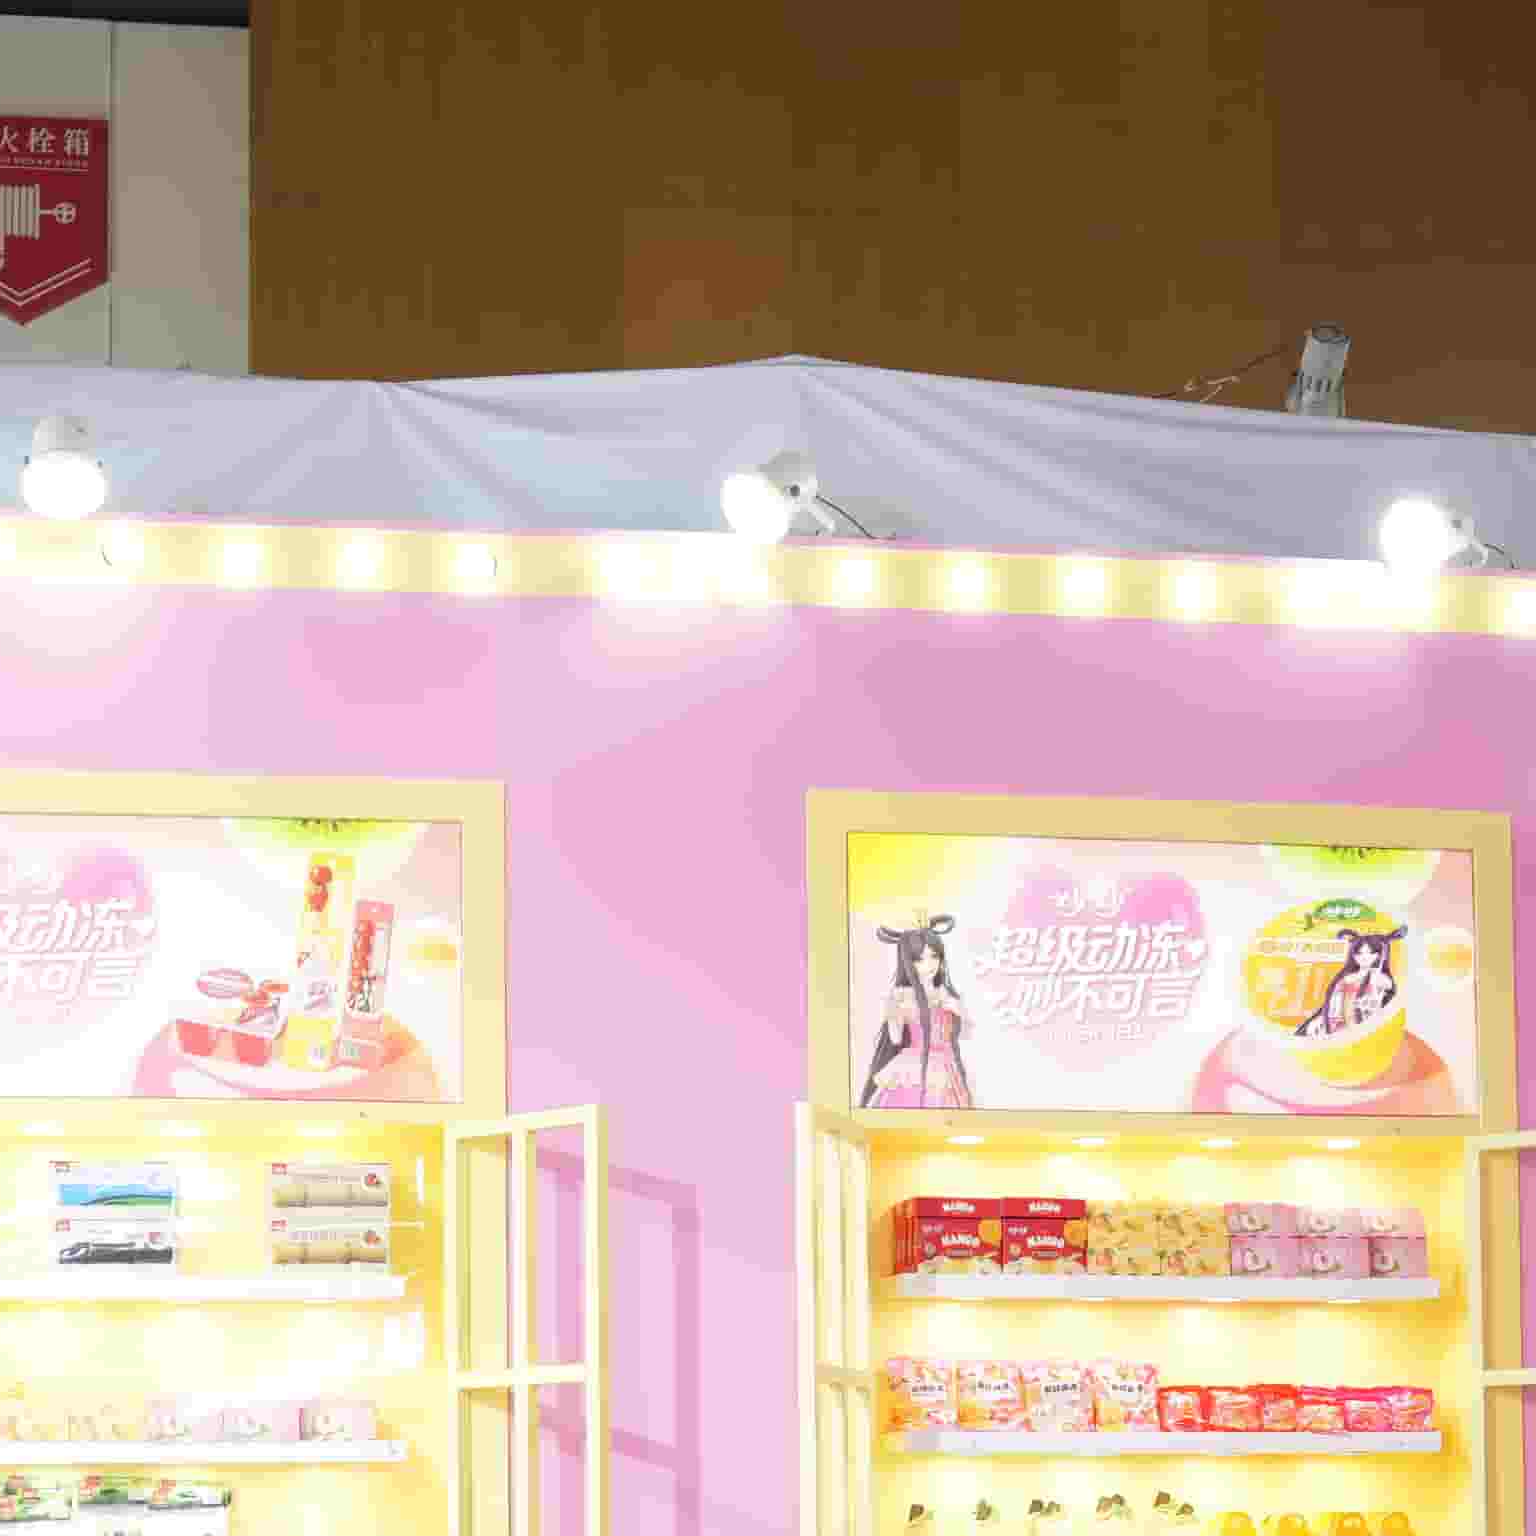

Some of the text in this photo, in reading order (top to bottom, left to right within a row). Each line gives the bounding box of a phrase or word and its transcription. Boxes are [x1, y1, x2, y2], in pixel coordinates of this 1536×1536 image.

[990, 922, 1188, 976] 超级动冻
[994, 974, 1194, 1028] 妙不可言
